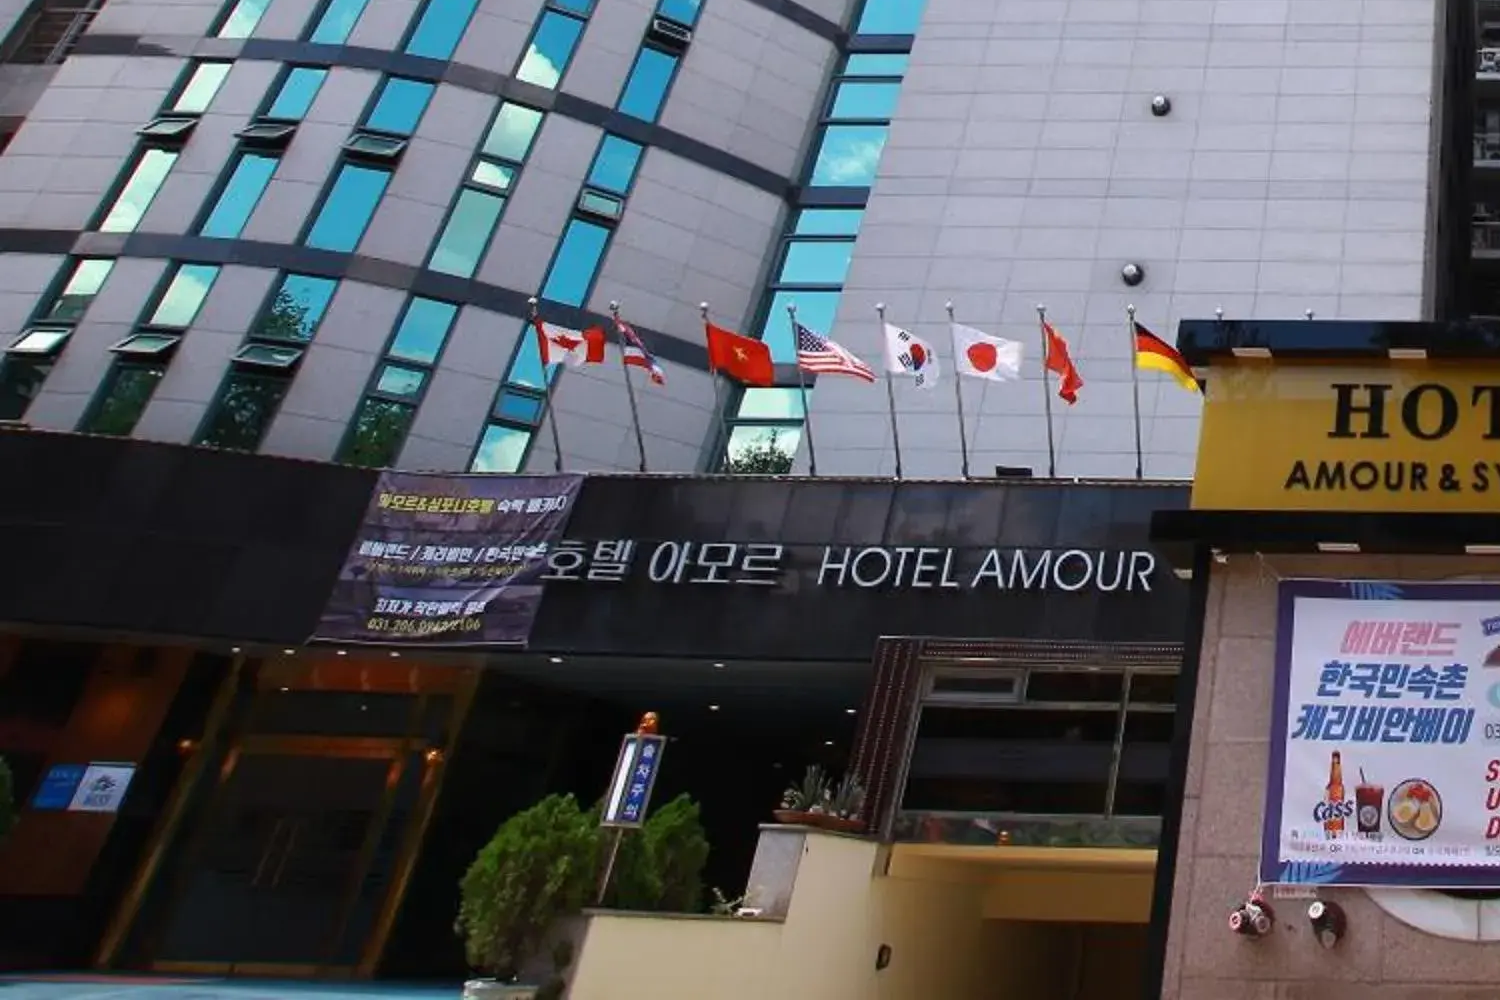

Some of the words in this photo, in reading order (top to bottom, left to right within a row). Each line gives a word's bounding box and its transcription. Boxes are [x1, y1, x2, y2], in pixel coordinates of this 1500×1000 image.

[1283, 460, 1428, 492] AMOUR
[1439, 464, 1461, 492] &
[540, 539, 633, 583] 호텔
[648, 540, 785, 585] 아모르
[817, 546, 960, 588] HOTEL
[970, 548, 1156, 592] AMOUR
[1340, 620, 1462, 656] 에버랜드
[1316, 659, 1469, 701] 한국민속촌
[1291, 703, 1475, 744] 캐리비안베이
